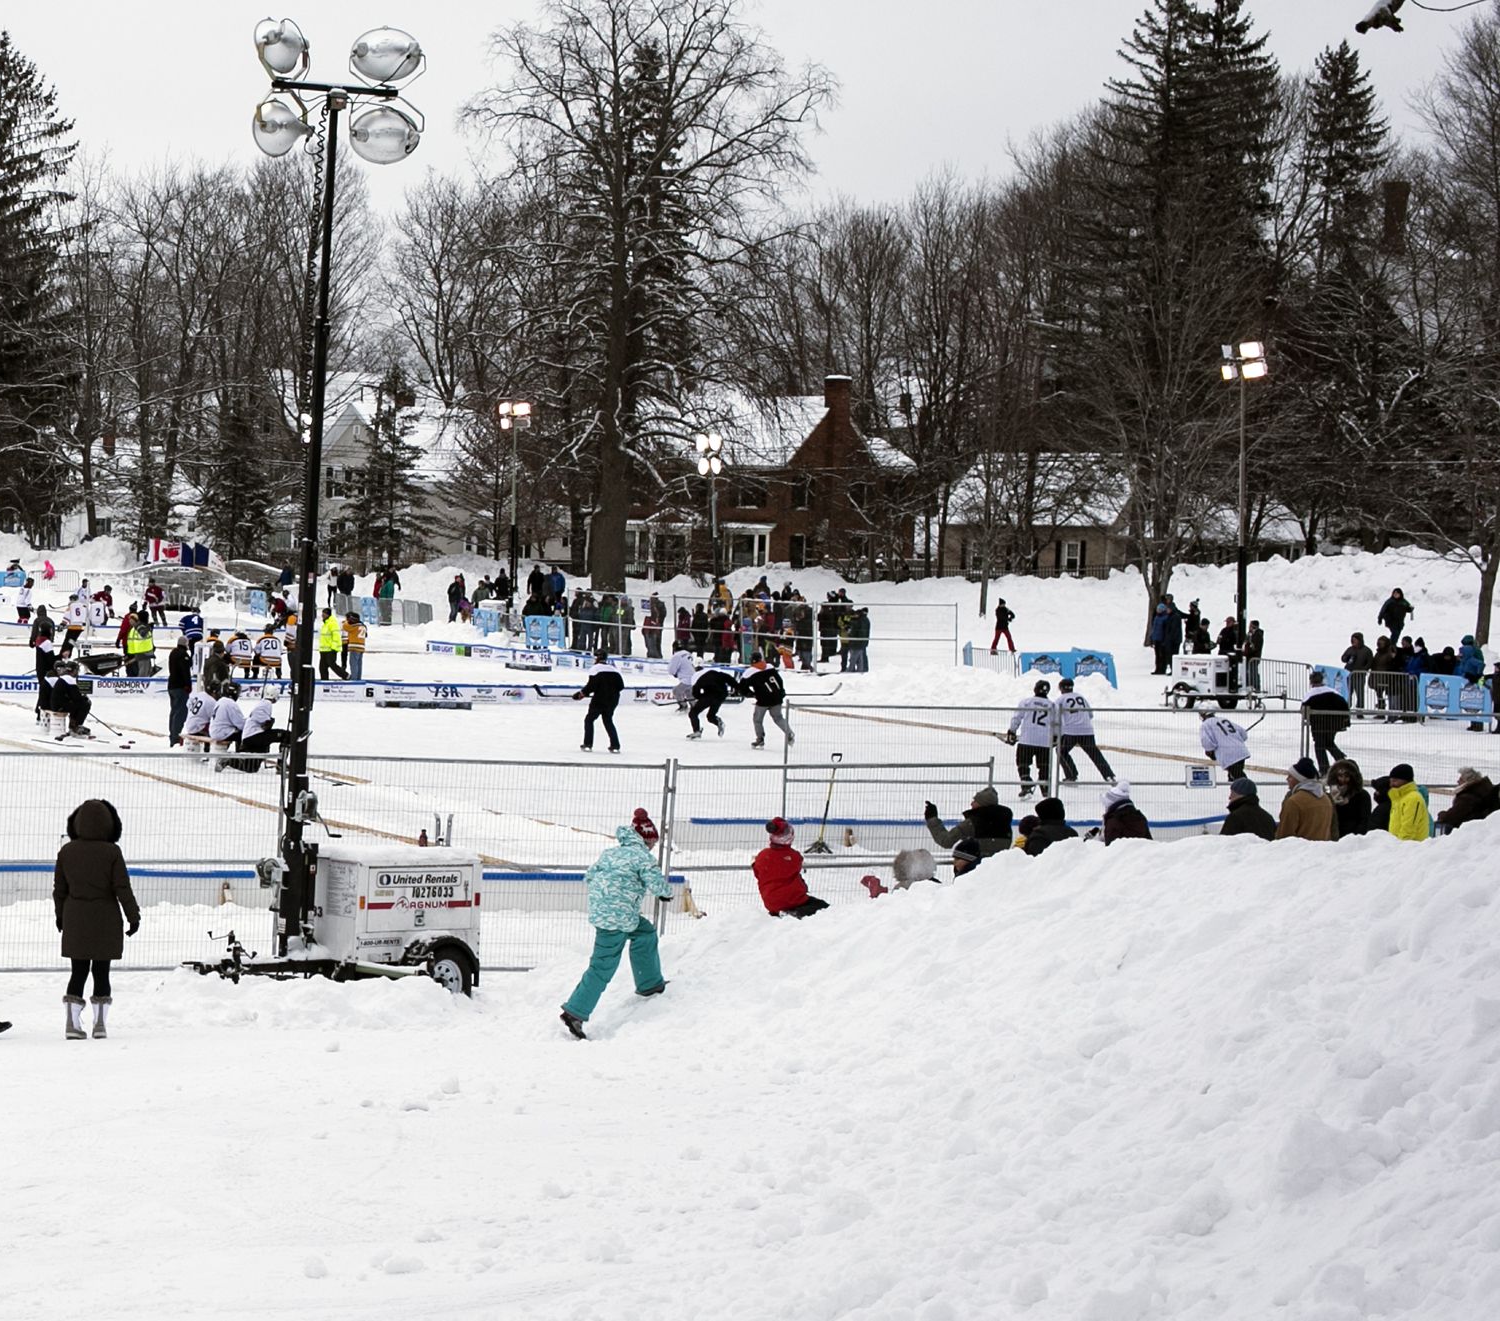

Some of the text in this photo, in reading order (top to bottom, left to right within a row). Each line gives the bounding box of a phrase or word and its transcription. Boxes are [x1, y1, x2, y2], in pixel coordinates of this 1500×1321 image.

[238, 640, 249, 651] 15
[264, 639, 278, 650] 20
[4, 680, 38, 691] LIGHT
[97, 681, 141, 689] BODYARMOR
[764, 676, 781, 693] 19
[365, 687, 374, 698] 6
[434, 687, 459, 698] TSR
[1066, 696, 1086, 714] 29
[1032, 709, 1048, 726] 12
[1216, 719, 1236, 736] 13
[393, 873, 458, 885] United Rentals
